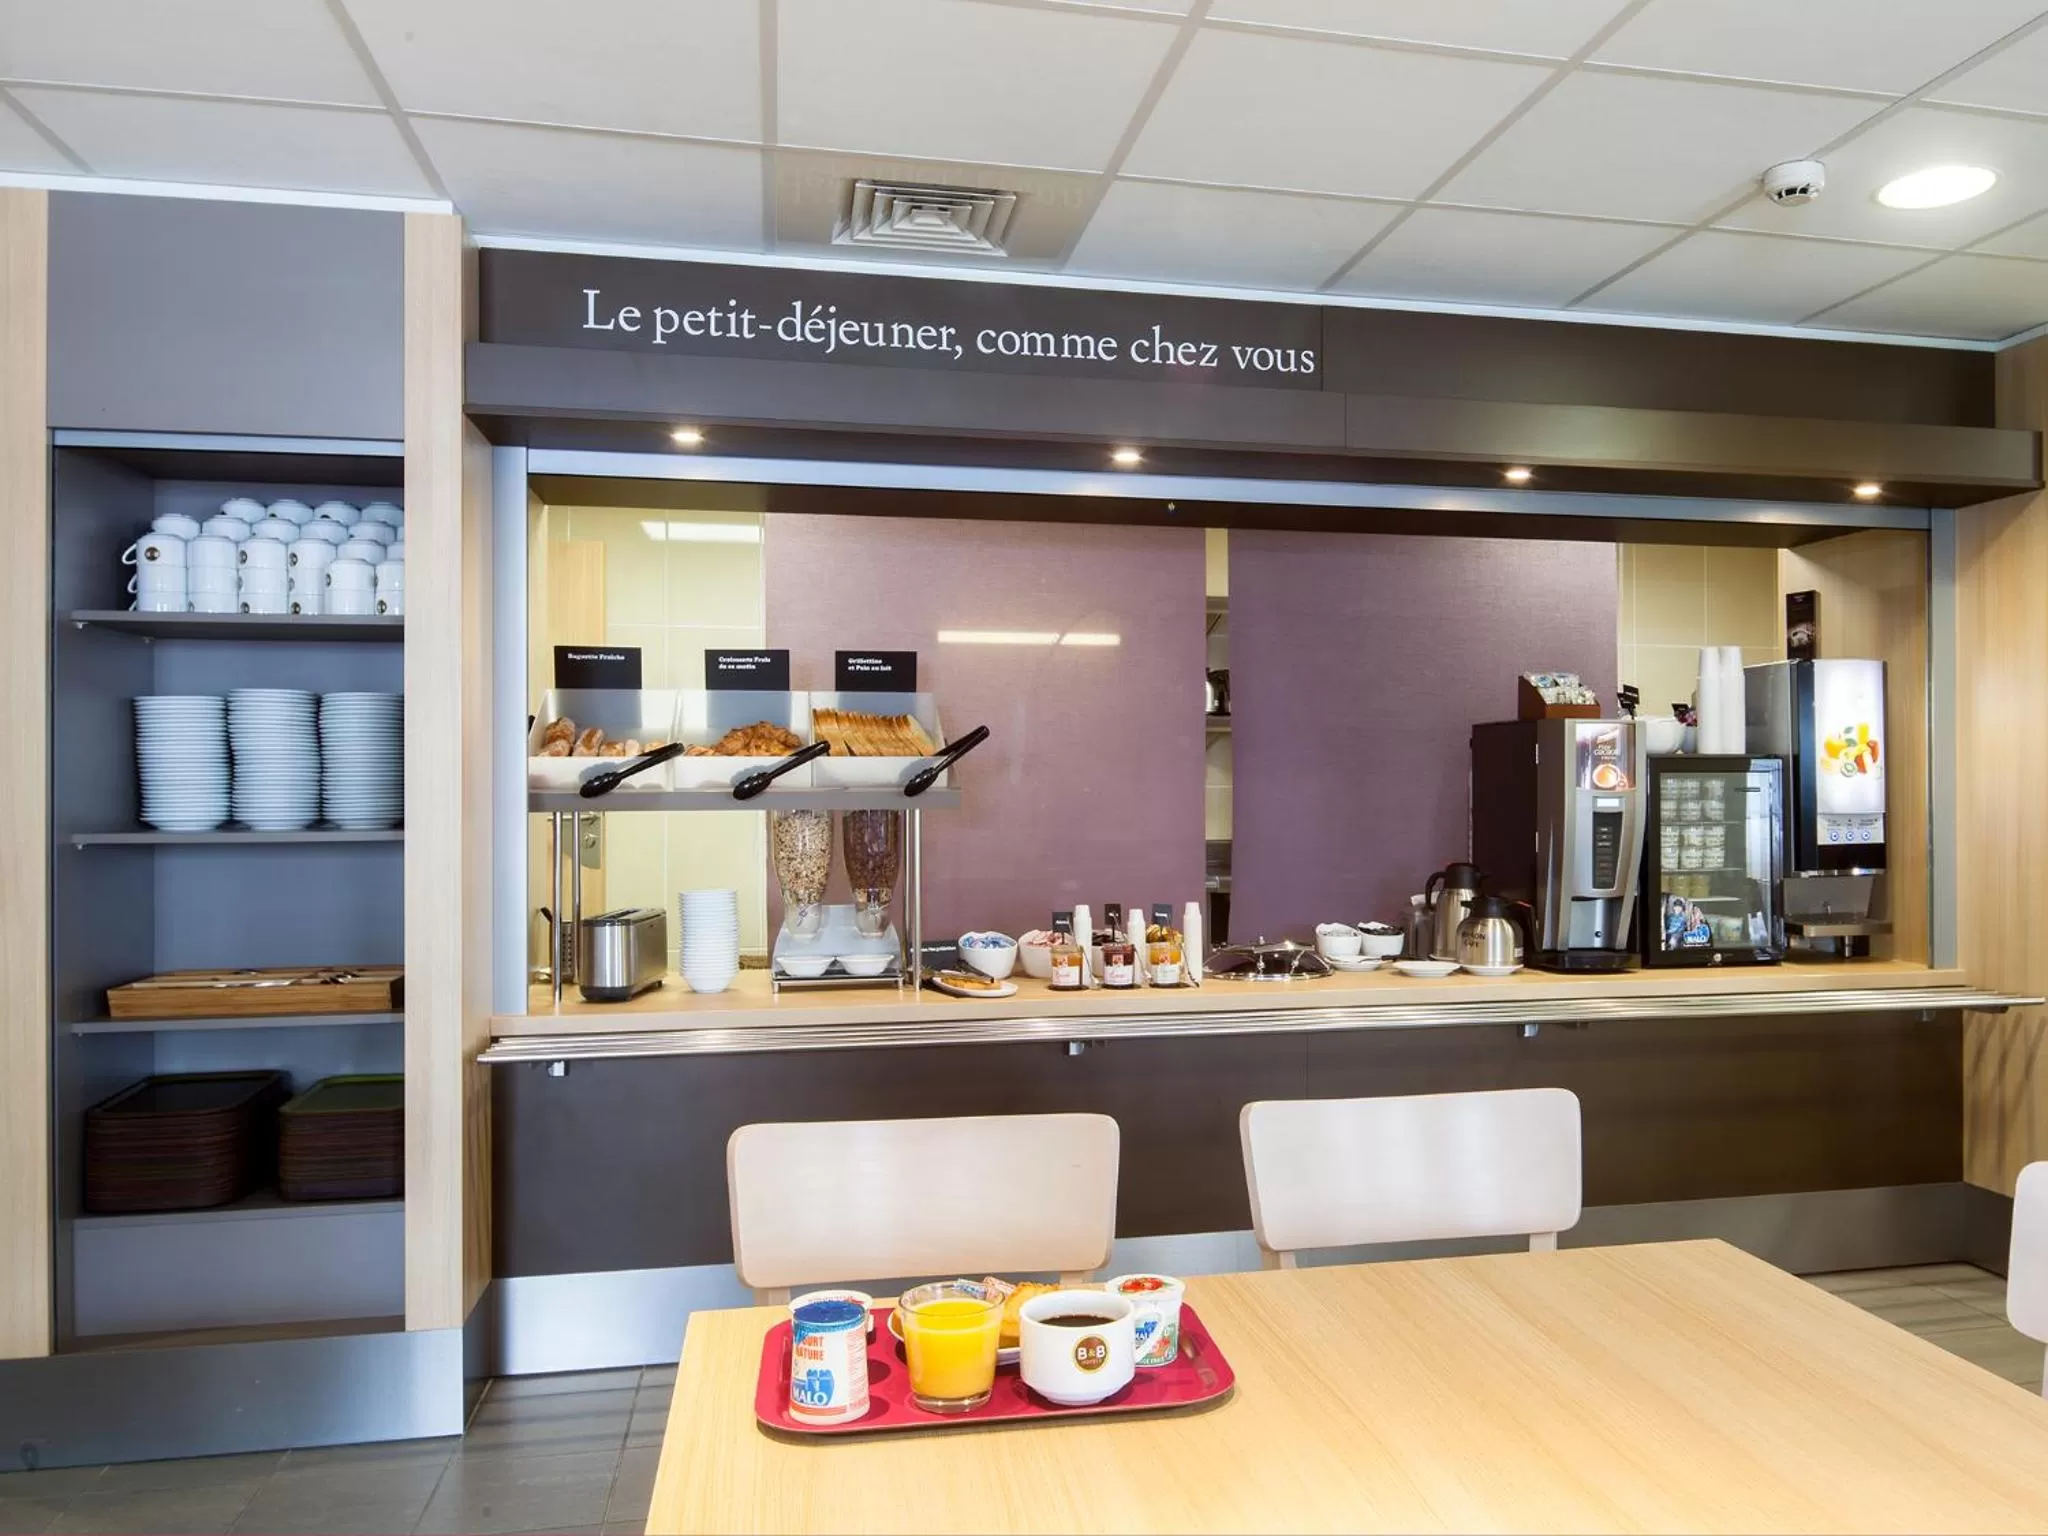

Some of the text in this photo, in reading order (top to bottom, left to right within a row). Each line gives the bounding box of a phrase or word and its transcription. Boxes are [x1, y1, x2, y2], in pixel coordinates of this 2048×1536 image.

[582, 288, 1315, 373] Le petit-déjeuner, comme chez vous
